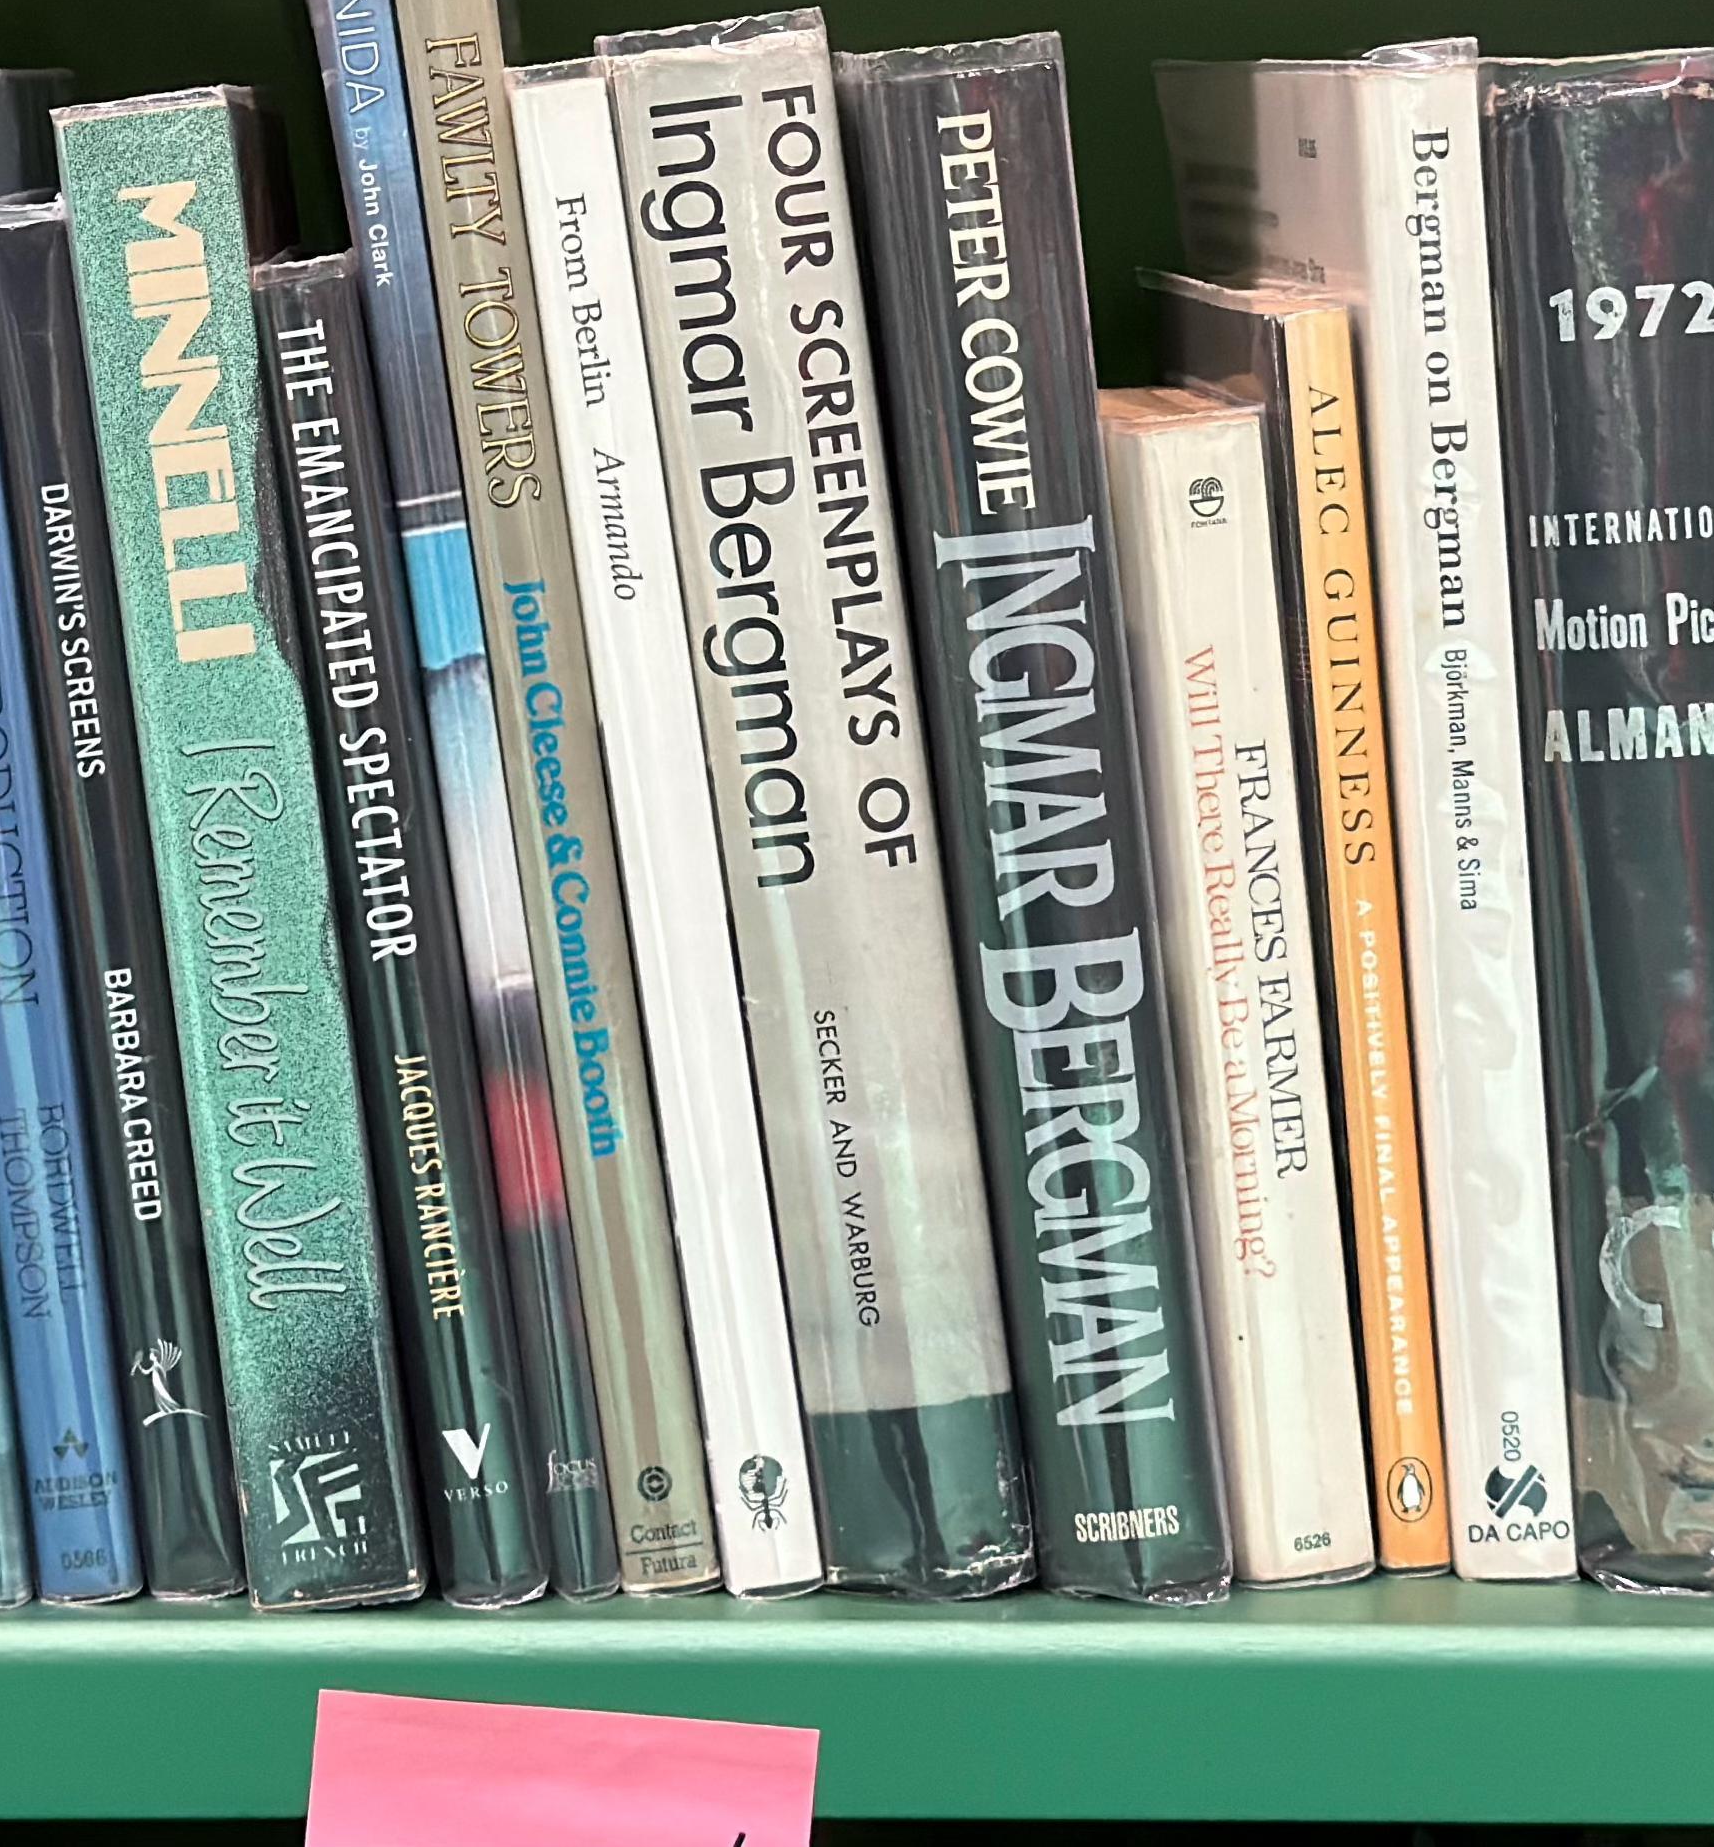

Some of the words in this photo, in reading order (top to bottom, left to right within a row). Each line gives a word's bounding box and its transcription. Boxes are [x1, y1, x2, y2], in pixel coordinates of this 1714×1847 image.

[353, 126, 372, 151] by
[359, 158, 379, 216] John
[425, 32, 506, 246] FAWLTY
[761, 84, 833, 275] FOUR
[368, 222, 392, 288] Clark
[557, 192, 588, 291] From
[936, 109, 1010, 309] PETER
[1405, 127, 1450, 336] Bergman
[278, 319, 333, 401] THE
[458, 267, 543, 508] TOWERS
[572, 298, 607, 407] Berlin
[1427, 351, 1451, 407] on
[118, 180, 255, 663] MINNELLI
[960, 317, 1036, 516] COWIE
[1309, 385, 1350, 536] ALEC
[593, 447, 636, 602] Armando
[639, 94, 753, 433] Ingmar
[699, 455, 815, 889] Bergman
[790, 299, 901, 747] SCREENPLAYS
[1424, 418, 1468, 629] Bergman
[42, 483, 86, 631] DARWIN'S
[292, 417, 379, 709] EMANCIPATED
[1534, 597, 1648, 652] Motion
[62, 637, 105, 778] SCREENS
[933, 515, 1116, 922] INGMAR
[1184, 644, 1219, 730] Will
[1323, 567, 1375, 866] GUINNESS
[1442, 649, 1469, 753] Björkman,
[181, 739, 275, 758] I
[1192, 733, 1225, 854] There
[1448, 759, 1476, 833] Manns
[339, 726, 417, 961] SPECTATOR
[503, 581, 548, 677] John
[526, 683, 569, 825] Cleese
[551, 872, 597, 1022] Connie
[574, 1023, 624, 1159] Booth
[857, 777, 917, 868] OF
[1233, 738, 1287, 963] FRANCES
[1456, 838, 1478, 852] &
[187, 767, 308, 1084] Remember
[1355, 900, 1373, 916] A
[1457, 856, 1480, 911] Sima
[104, 967, 148, 1113] BARBARA
[814, 1010, 847, 1105] SECKER
[1219, 990, 1248, 1049] Be
[1258, 971, 1308, 1178] FARMER
[1358, 930, 1389, 1098] POSITIVELY
[123, 1119, 162, 1221] CREED
[395, 1054, 441, 1175] JACQUES
[829, 1119, 857, 1178] AND
[1375, 1117, 1397, 1197] FINAL
[232, 1157, 346, 1311] Well
[980, 927, 1176, 1426] BERGMAN
[842, 1191, 880, 1328] WARBURG
[1382, 1216, 1413, 1415] APPEARANCE
[444, 1479, 509, 1503] VERSO
[1500, 1411, 1521, 1463] 0520
[630, 1518, 699, 1544] Contact
[1074, 1506, 1180, 1543] SCRIBNERS
[1294, 1532, 1331, 1553] 6526
[1467, 1524, 1500, 1543] DA
[1506, 1520, 1571, 1541] CAPO
